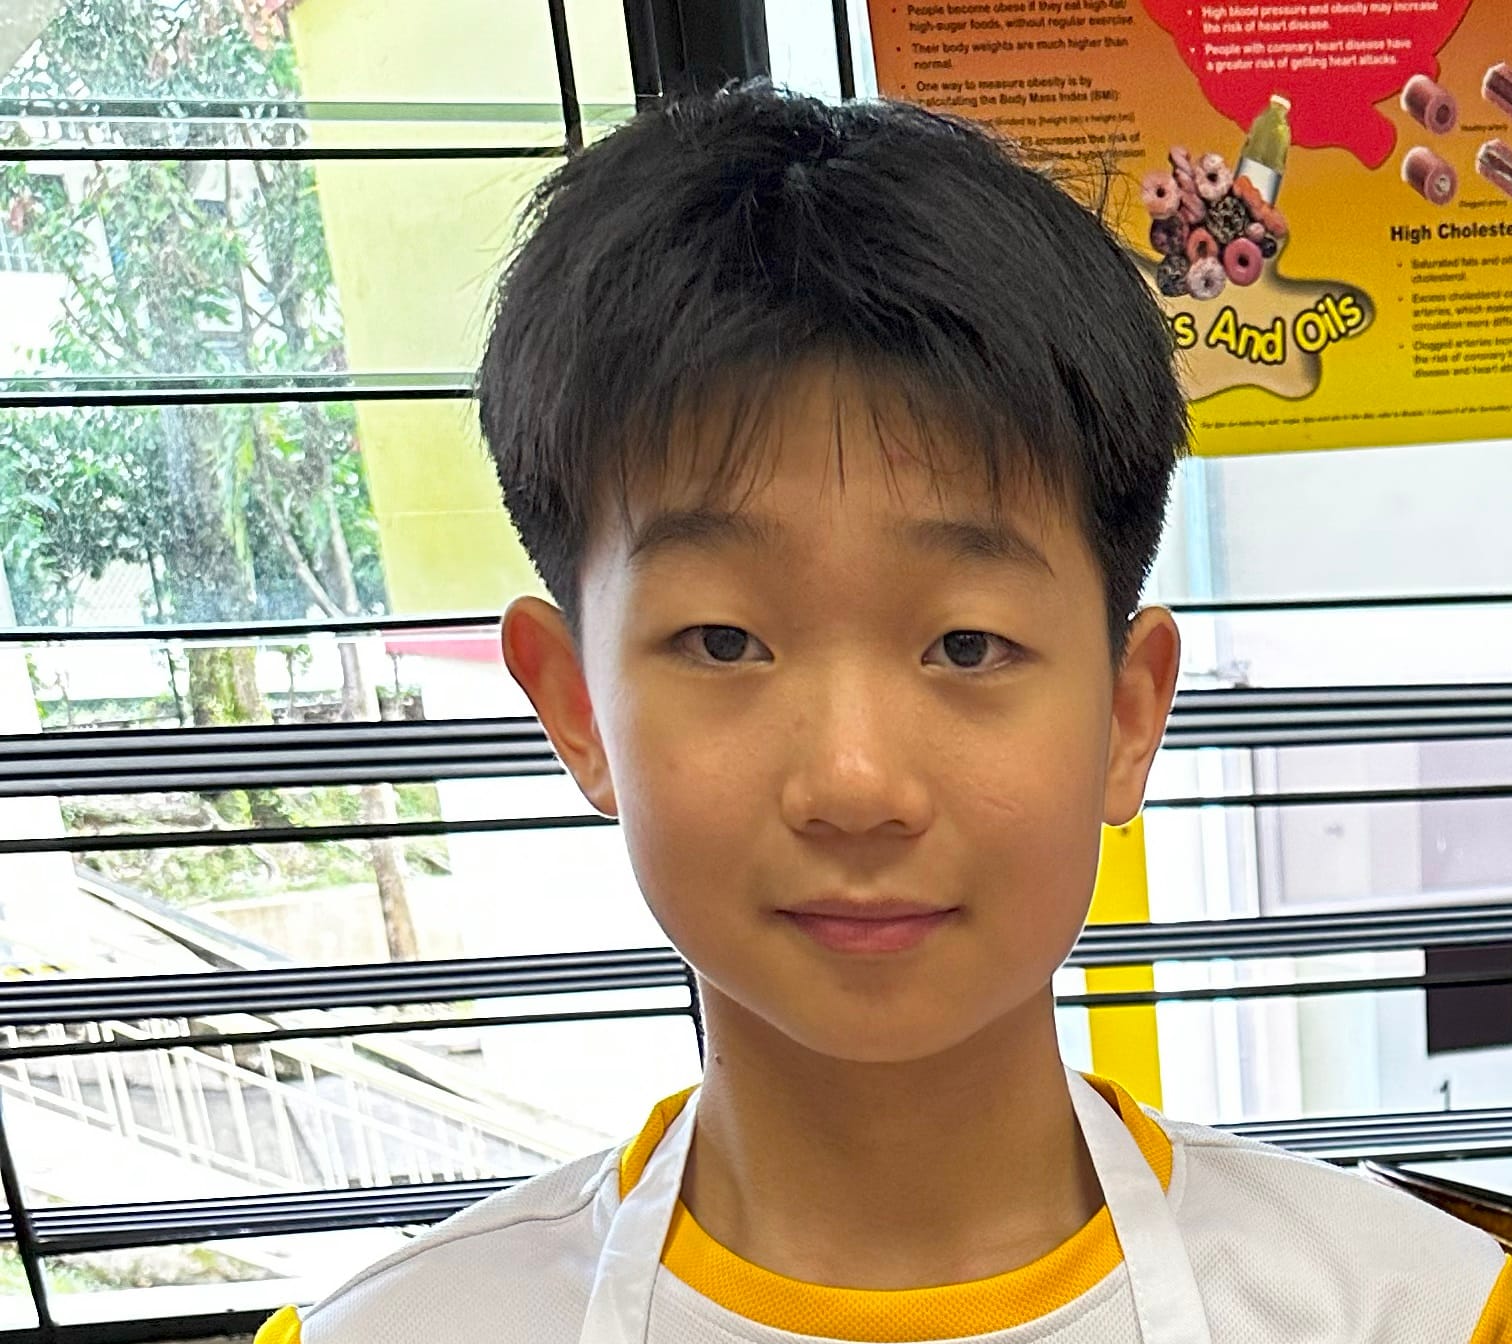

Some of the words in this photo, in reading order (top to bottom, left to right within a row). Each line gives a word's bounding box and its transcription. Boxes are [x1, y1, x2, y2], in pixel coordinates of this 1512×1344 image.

[908, 4, 944, 16] People
[948, 3, 990, 14] become
[994, 3, 1025, 12] obese
[1039, 1, 1062, 14] they
[1202, 6, 1226, 20] High
[1229, 7, 1258, 17] blood
[1261, 5, 1306, 18] pressure
[1309, 4, 1328, 14] and
[1331, 3, 1367, 15] obesity
[1370, 3, 1391, 14] may
[1006, 18, 1045, 28] without
[1048, 17, 1086, 29] regular
[1203, 23, 1220, 33] the
[1223, 22, 1241, 32] risk
[1244, 21, 1255, 31] of
[1258, 21, 1286, 31] heart
[912, 43, 940, 53] Their
[942, 42, 969, 54] body
[972, 40, 1014, 53] weights
[1017, 40, 1034, 49] are
[1037, 39, 1065, 49] much
[1068, 38, 1101, 51] higher
[1104, 38, 1128, 47] than
[1205, 44, 1241, 56] People
[1243, 43, 1265, 53] with
[1267, 42, 1314, 54] coronary
[1315, 41, 1343, 51] heart
[1346, 39, 1384, 49] disease
[1216, 60, 1253, 74] greater
[1255, 59, 1274, 68] risk
[1277, 58, 1288, 67] of
[1291, 56, 1327, 70] getting
[1329, 56, 1356, 67] heart
[916, 81, 938, 91] One
[942, 81, 962, 93] way
[965, 80, 975, 90] to
[979, 79, 1024, 89] measure
[1027, 76, 1065, 89] obesity
[1080, 76, 1092, 88] by
[980, 95, 996, 105] the
[1000, 94, 1027, 105] Body
[1030, 93, 1056, 103] Mass
[1059, 91, 1087, 102] Index
[1390, 225, 1432, 244] High
[1205, 305, 1286, 365] And
[1293, 293, 1364, 354] Oils
